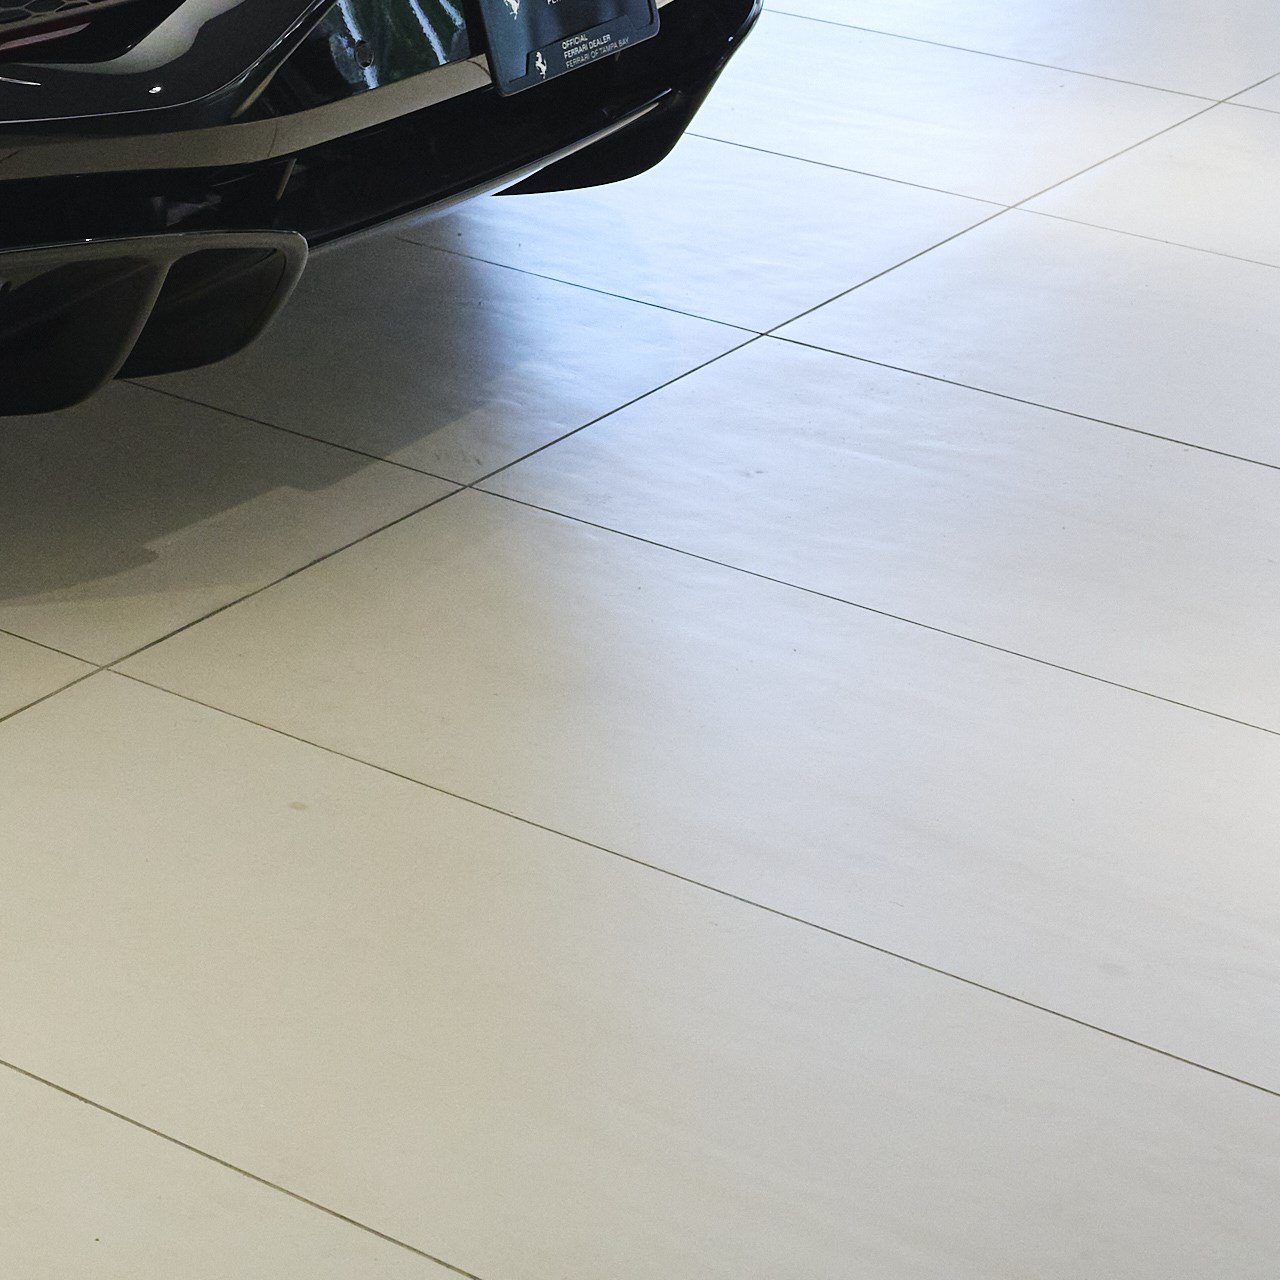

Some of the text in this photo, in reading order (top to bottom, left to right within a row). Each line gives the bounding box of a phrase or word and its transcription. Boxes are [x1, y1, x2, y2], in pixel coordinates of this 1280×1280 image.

[561, 34, 588, 49] OFFICIAL
[564, 34, 611, 59] FERRARI DEALER
[566, 53, 590, 68] FERRARI
[591, 49, 599, 59] OF
